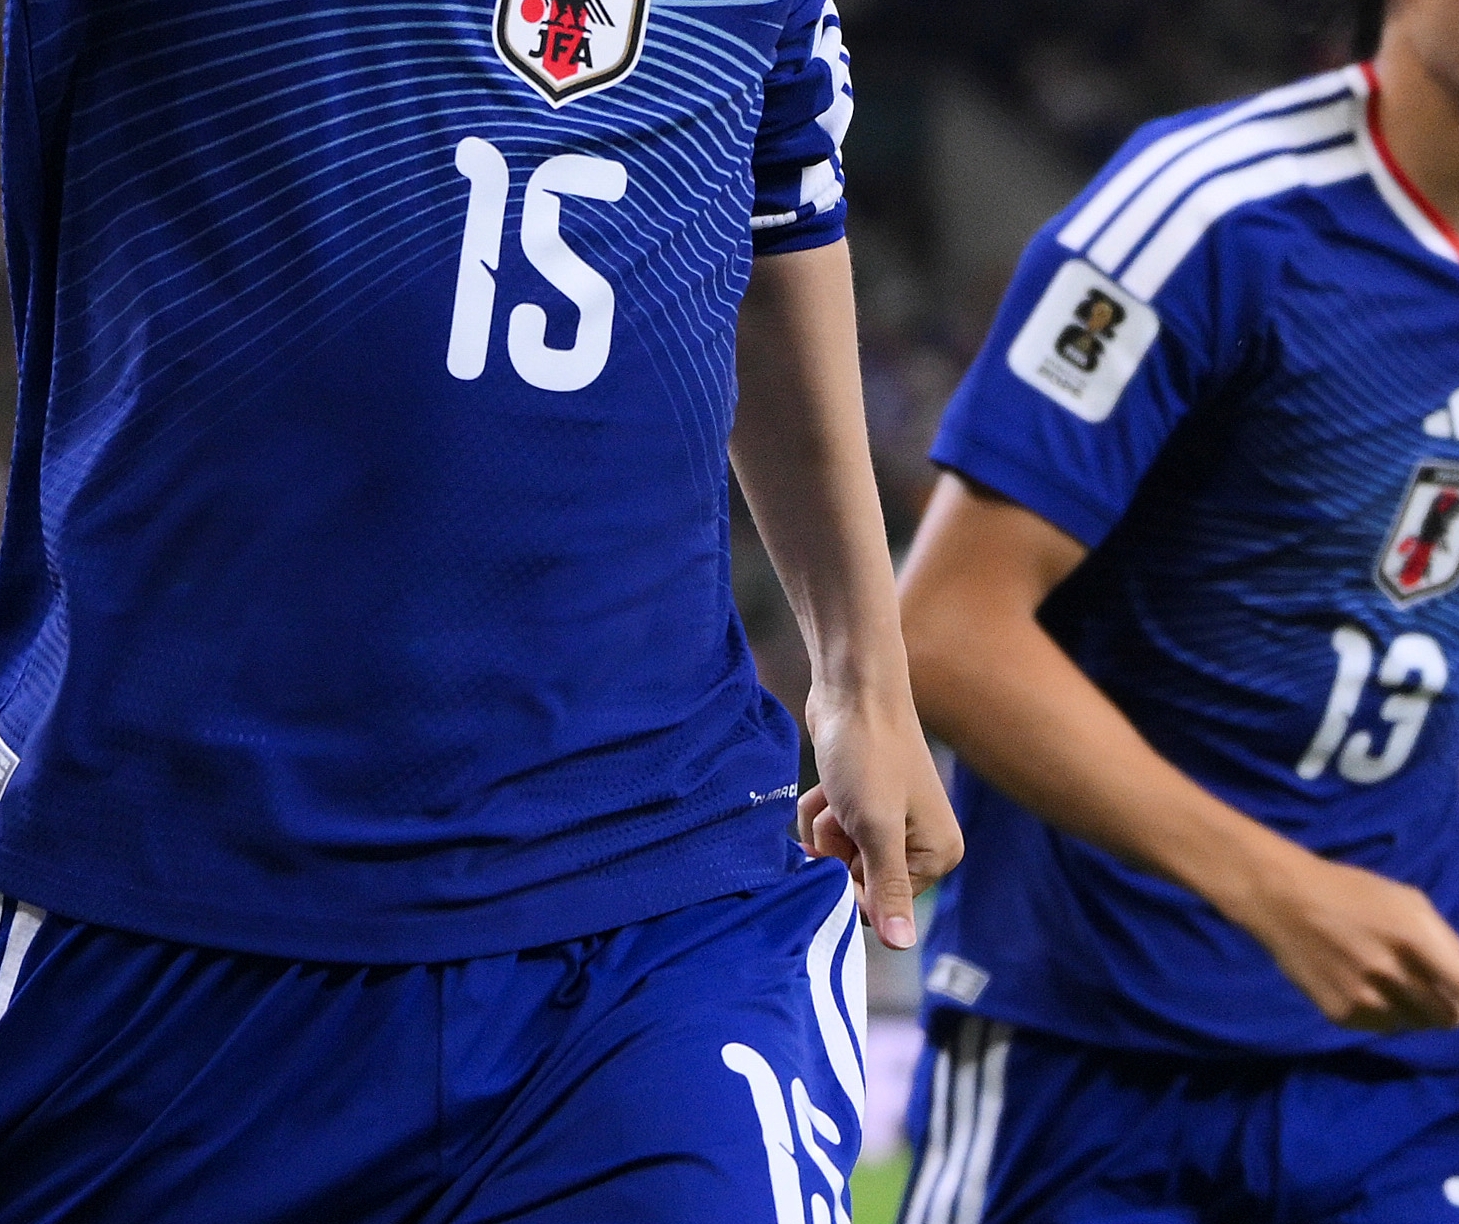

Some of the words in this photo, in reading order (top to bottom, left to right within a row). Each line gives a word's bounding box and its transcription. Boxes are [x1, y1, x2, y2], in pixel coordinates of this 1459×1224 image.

[528, 29, 593, 69] JFA
[446, 136, 628, 392] 15
[1296, 627, 1448, 785] 13
